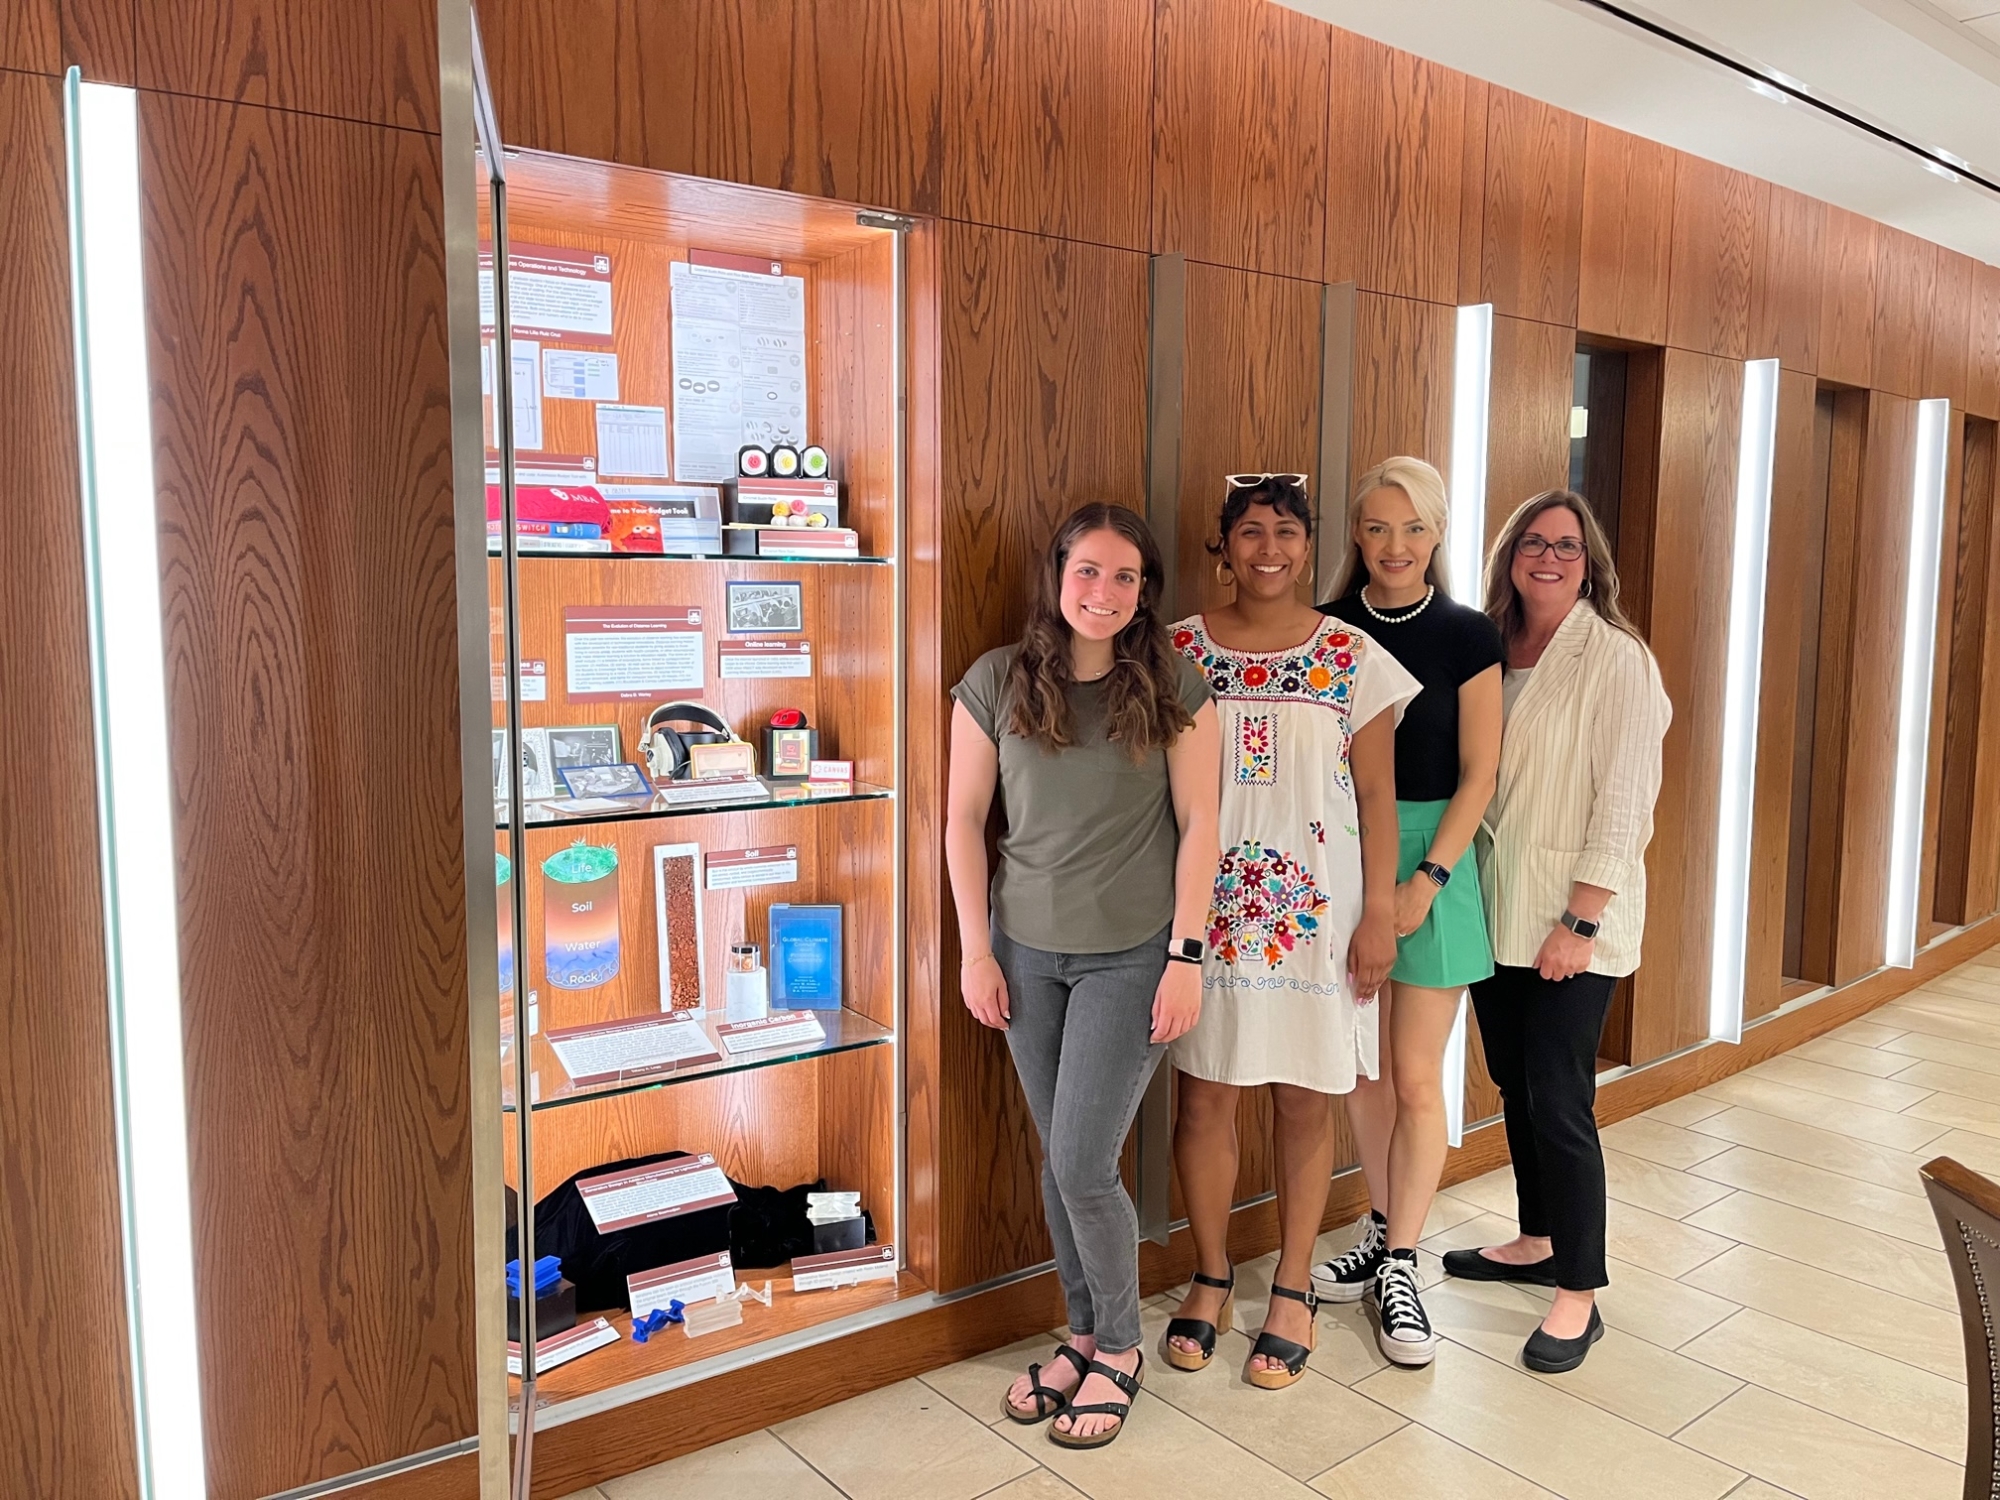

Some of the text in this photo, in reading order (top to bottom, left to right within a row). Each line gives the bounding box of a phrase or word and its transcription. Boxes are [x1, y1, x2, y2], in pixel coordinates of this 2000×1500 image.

[519, 261, 546, 271] Operations
[559, 265, 586, 275] Technology
[570, 493, 599, 504] MBA
[648, 507, 672, 515] Budget
[516, 524, 546, 532] SWITCH
[823, 765, 848, 774] CANVAS
[745, 850, 759, 858] Soil
[571, 863, 592, 874] Life
[571, 901, 593, 913] Soil
[565, 940, 601, 952] Water
[569, 972, 598, 985] Rock
[730, 1014, 796, 1029] Inorganic Carbon
